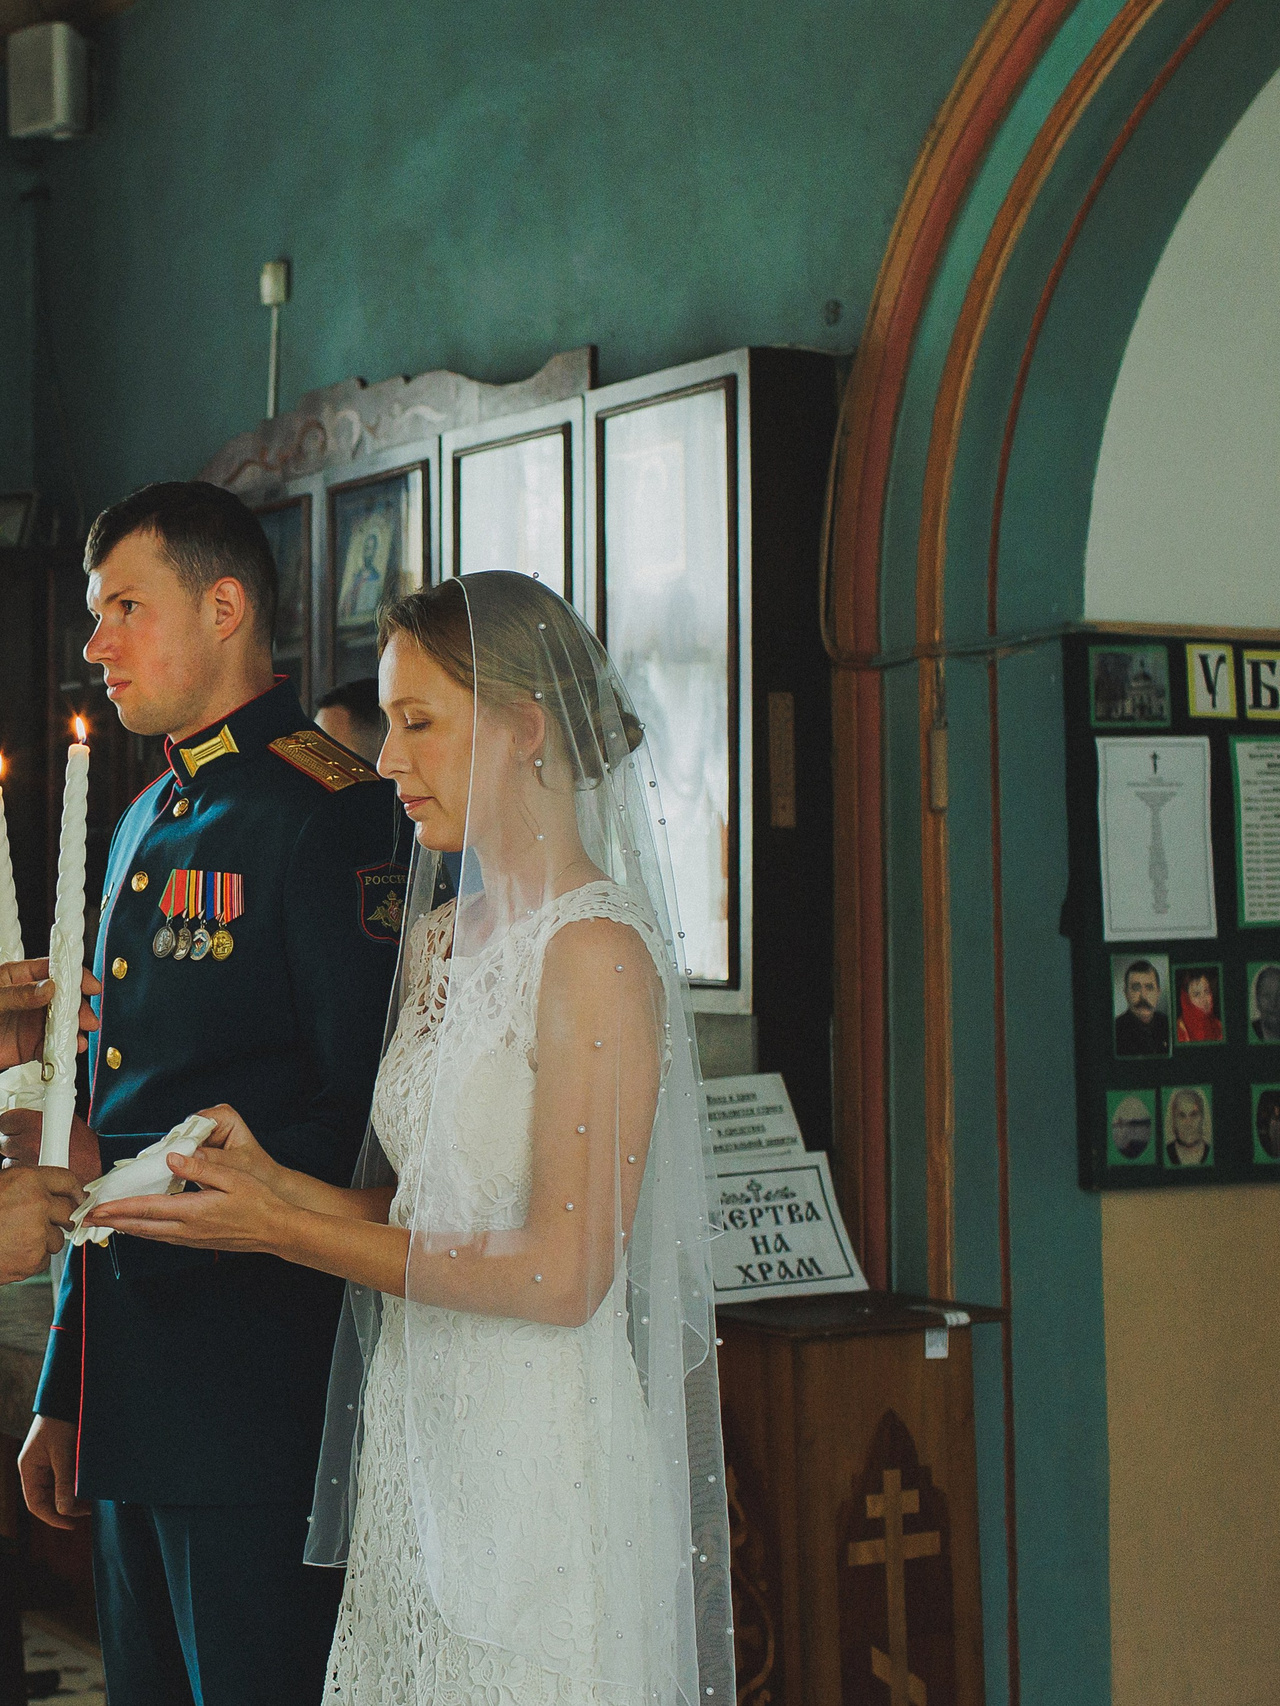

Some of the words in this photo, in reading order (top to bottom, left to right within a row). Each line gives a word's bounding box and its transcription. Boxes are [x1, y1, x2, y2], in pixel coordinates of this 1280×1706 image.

[364, 874, 412, 886] РОССИ
[749, 1231, 792, 1256] НА
[734, 1256, 824, 1284] ХРАМ
